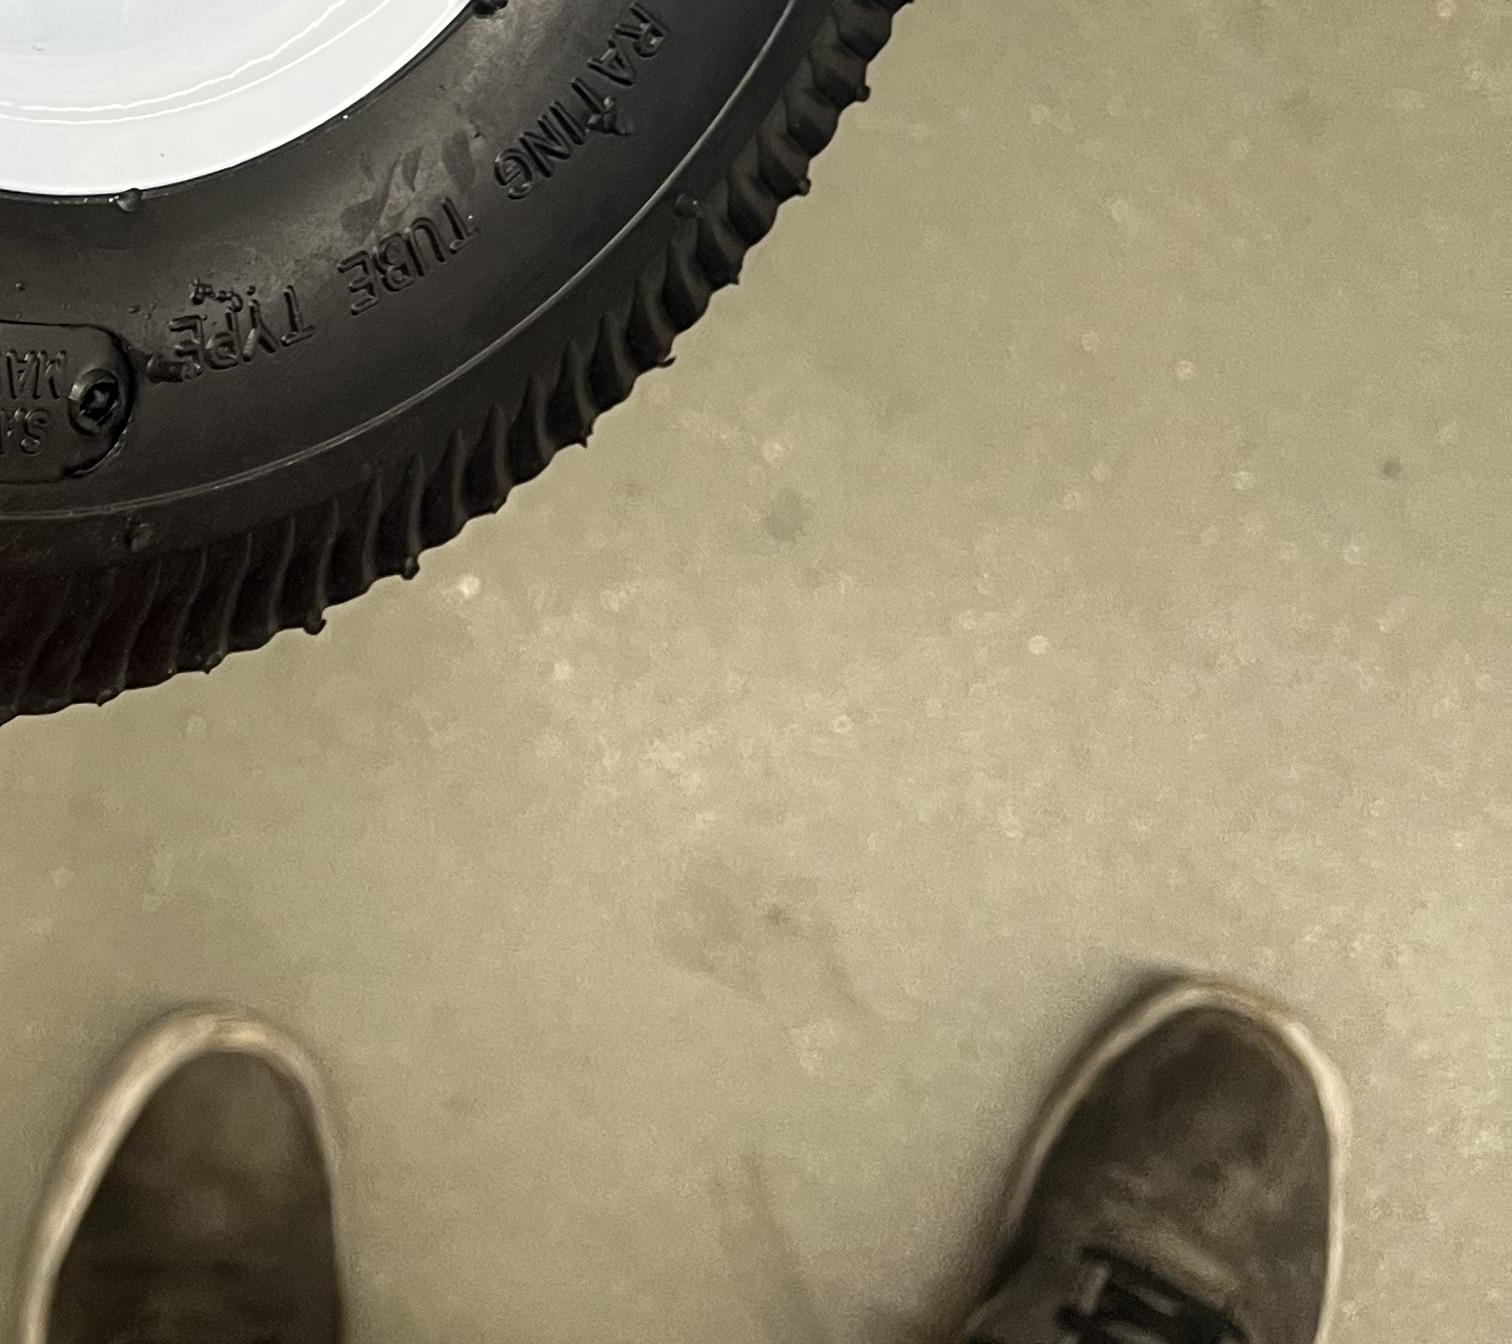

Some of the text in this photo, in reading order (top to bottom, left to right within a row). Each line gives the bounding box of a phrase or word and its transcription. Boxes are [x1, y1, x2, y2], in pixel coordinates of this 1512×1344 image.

[493, 2, 670, 200] RATING
[337, 197, 480, 316] TUBE
[169, 284, 316, 381] TYPE
